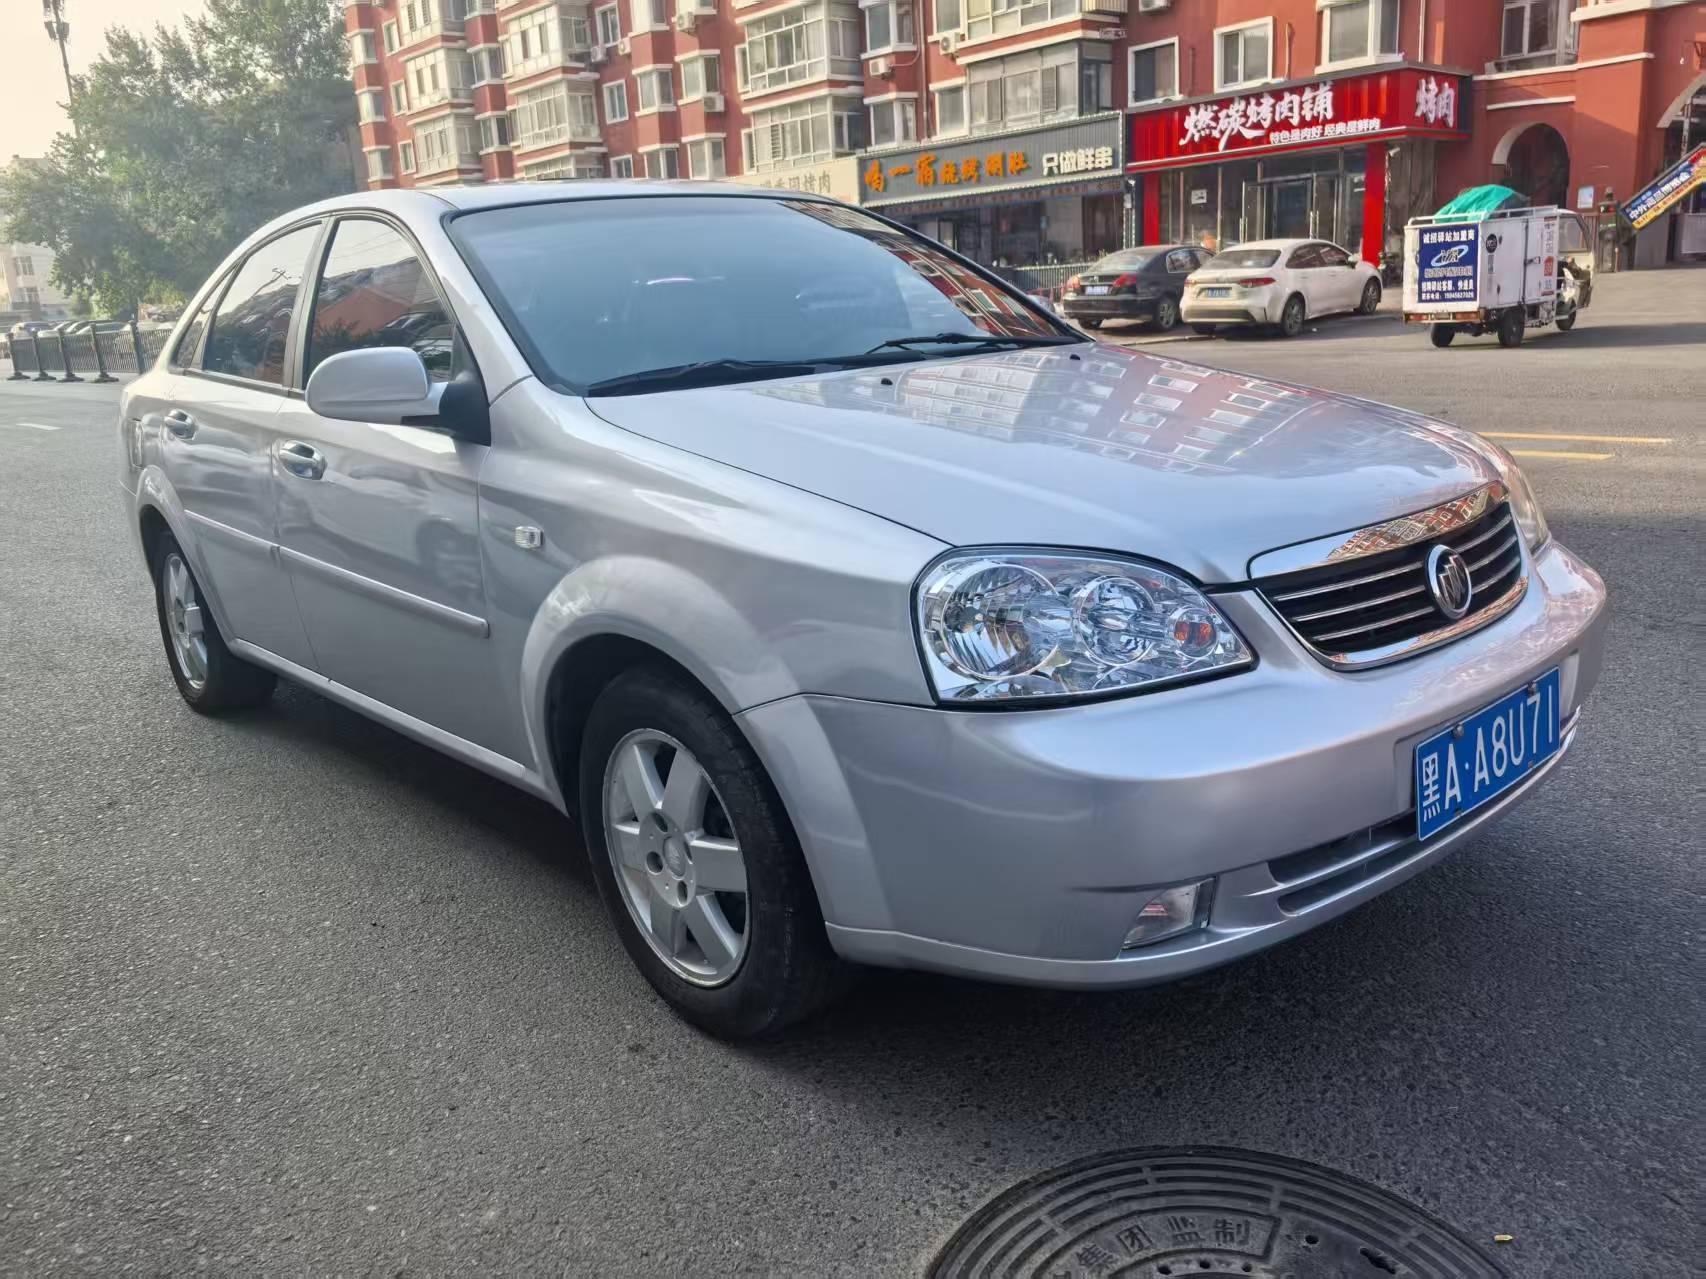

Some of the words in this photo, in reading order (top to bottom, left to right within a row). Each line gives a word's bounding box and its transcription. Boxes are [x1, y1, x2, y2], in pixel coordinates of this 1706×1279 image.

[1179, 81, 1334, 151] 燃碳烤肉铺
[1414, 75, 1456, 128] 烤肉
[1042, 146, 1113, 176] 只做鲜串
[1053, 1214, 1251, 1279] 集团监制
